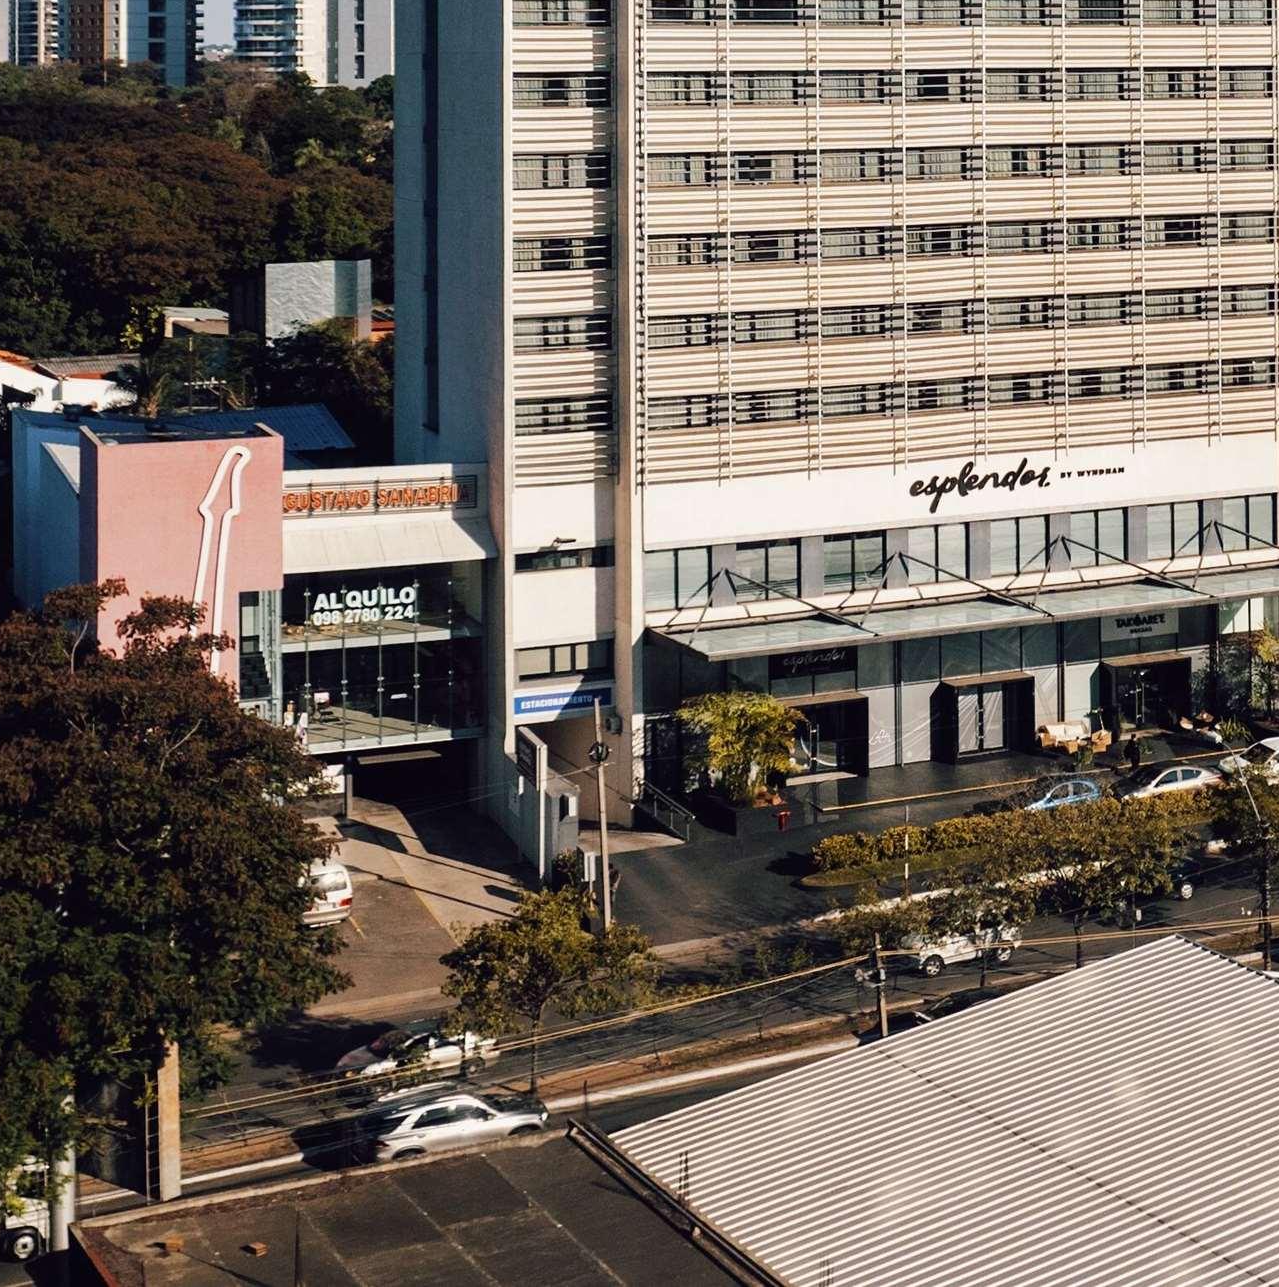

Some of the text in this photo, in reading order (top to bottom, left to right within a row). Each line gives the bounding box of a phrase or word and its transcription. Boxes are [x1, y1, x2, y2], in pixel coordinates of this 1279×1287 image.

[909, 457, 1125, 513] esplendor BY WYNDHAM
[284, 489, 371, 511] GUSTAVO
[313, 586, 416, 610] ALQUILO
[312, 604, 414, 626] 098 2780 224
